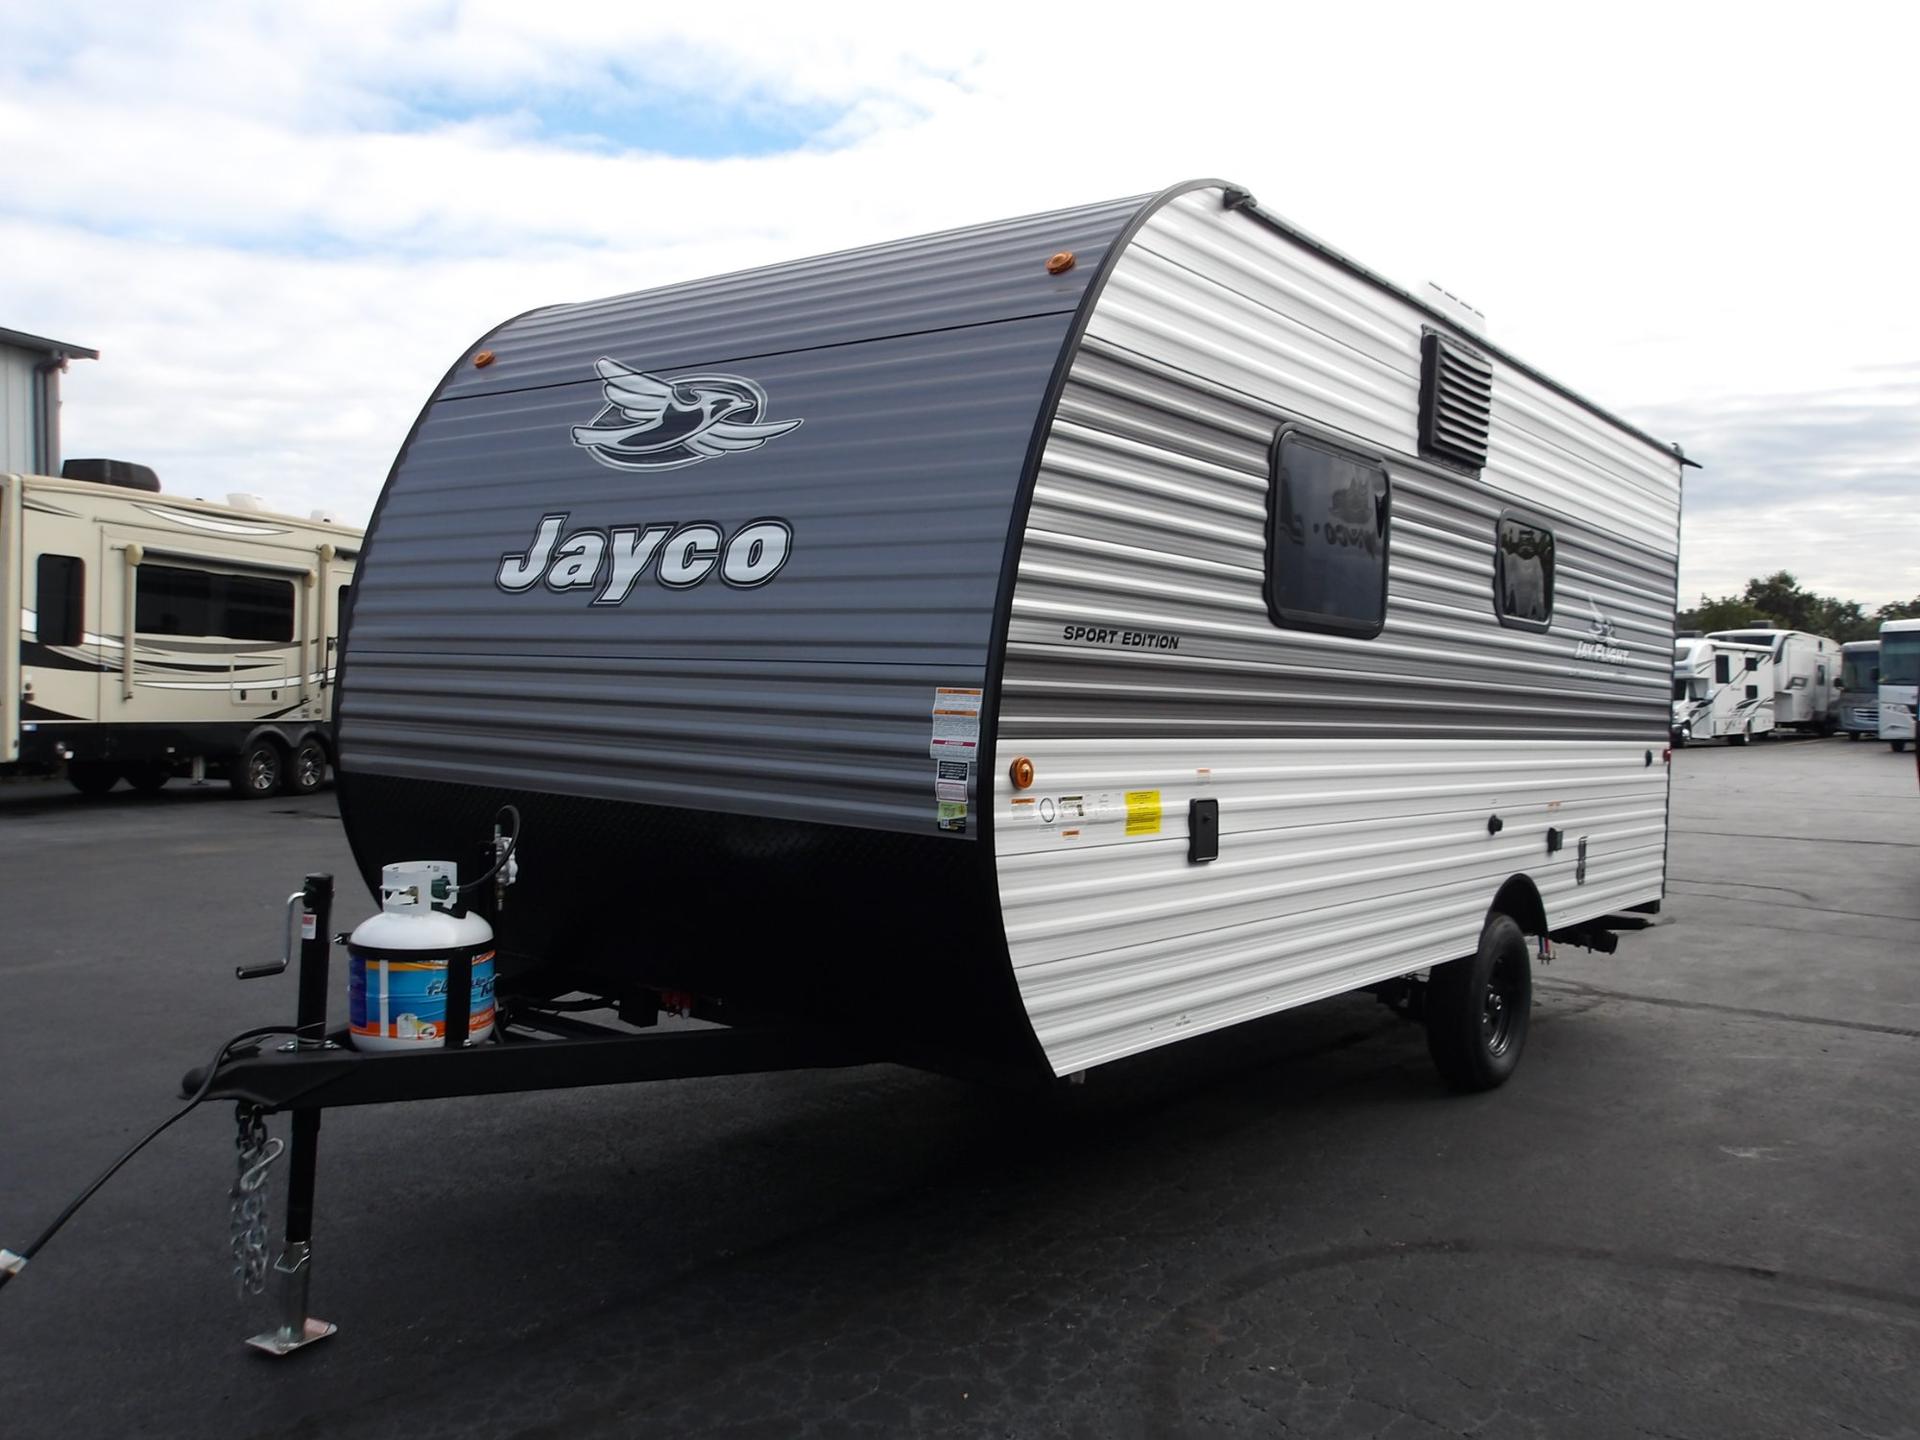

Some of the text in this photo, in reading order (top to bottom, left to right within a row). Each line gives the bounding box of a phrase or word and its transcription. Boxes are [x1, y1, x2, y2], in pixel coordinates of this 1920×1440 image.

[495, 511, 794, 607] Jayco
[1063, 625, 1180, 650] SPORT EDITION
